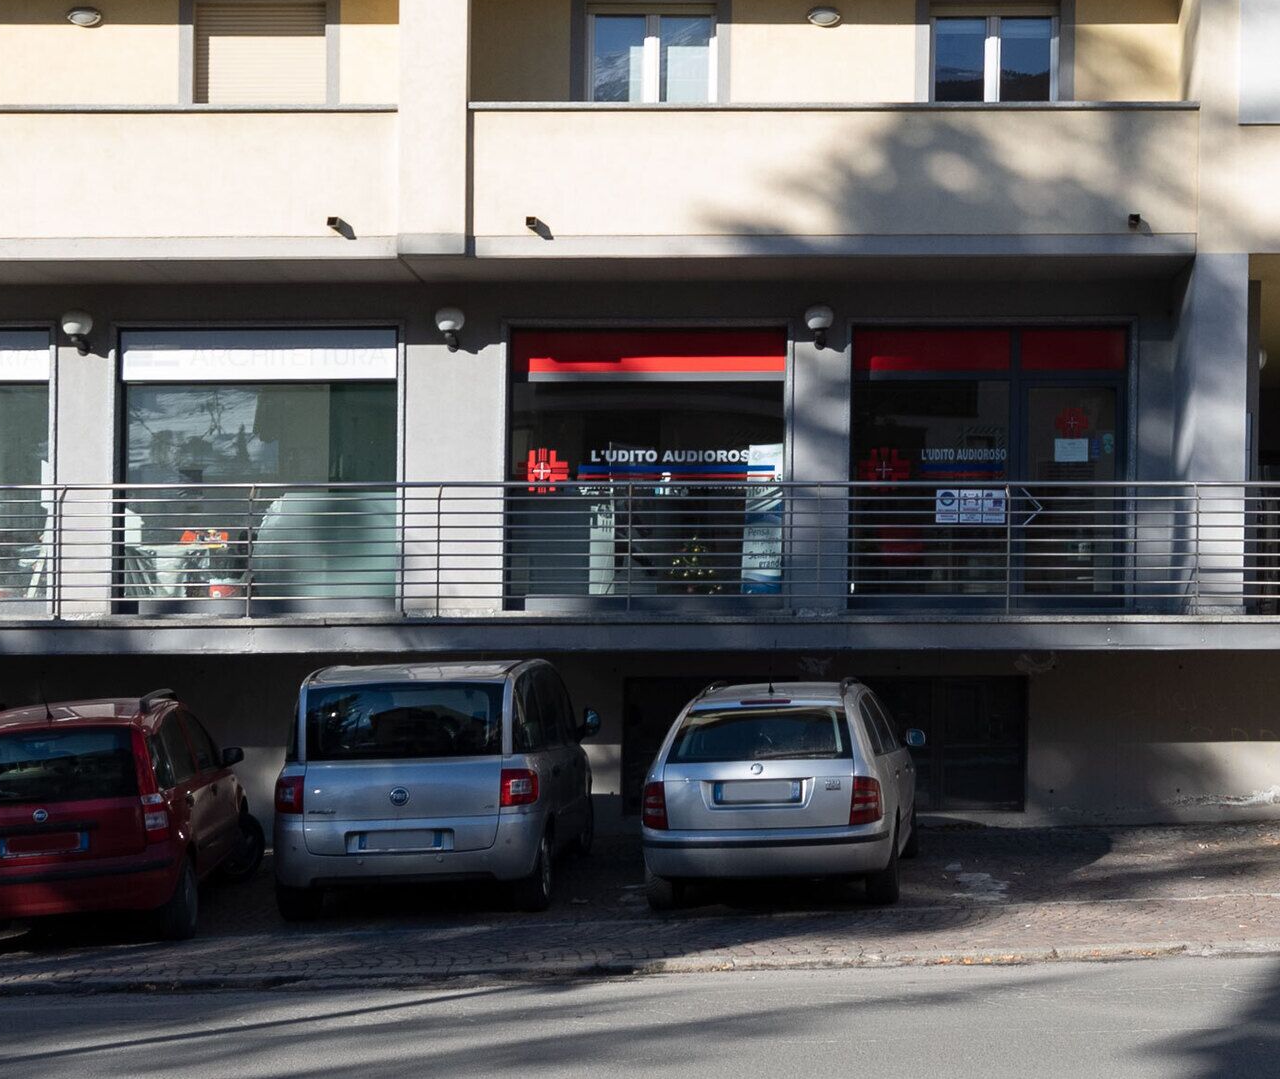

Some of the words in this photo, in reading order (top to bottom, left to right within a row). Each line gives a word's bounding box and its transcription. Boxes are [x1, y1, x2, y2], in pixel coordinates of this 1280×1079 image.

[590, 449, 658, 463] L'UDITO
[921, 448, 955, 461] L'UDITO
[956, 448, 1007, 461] AUDIOROSO
